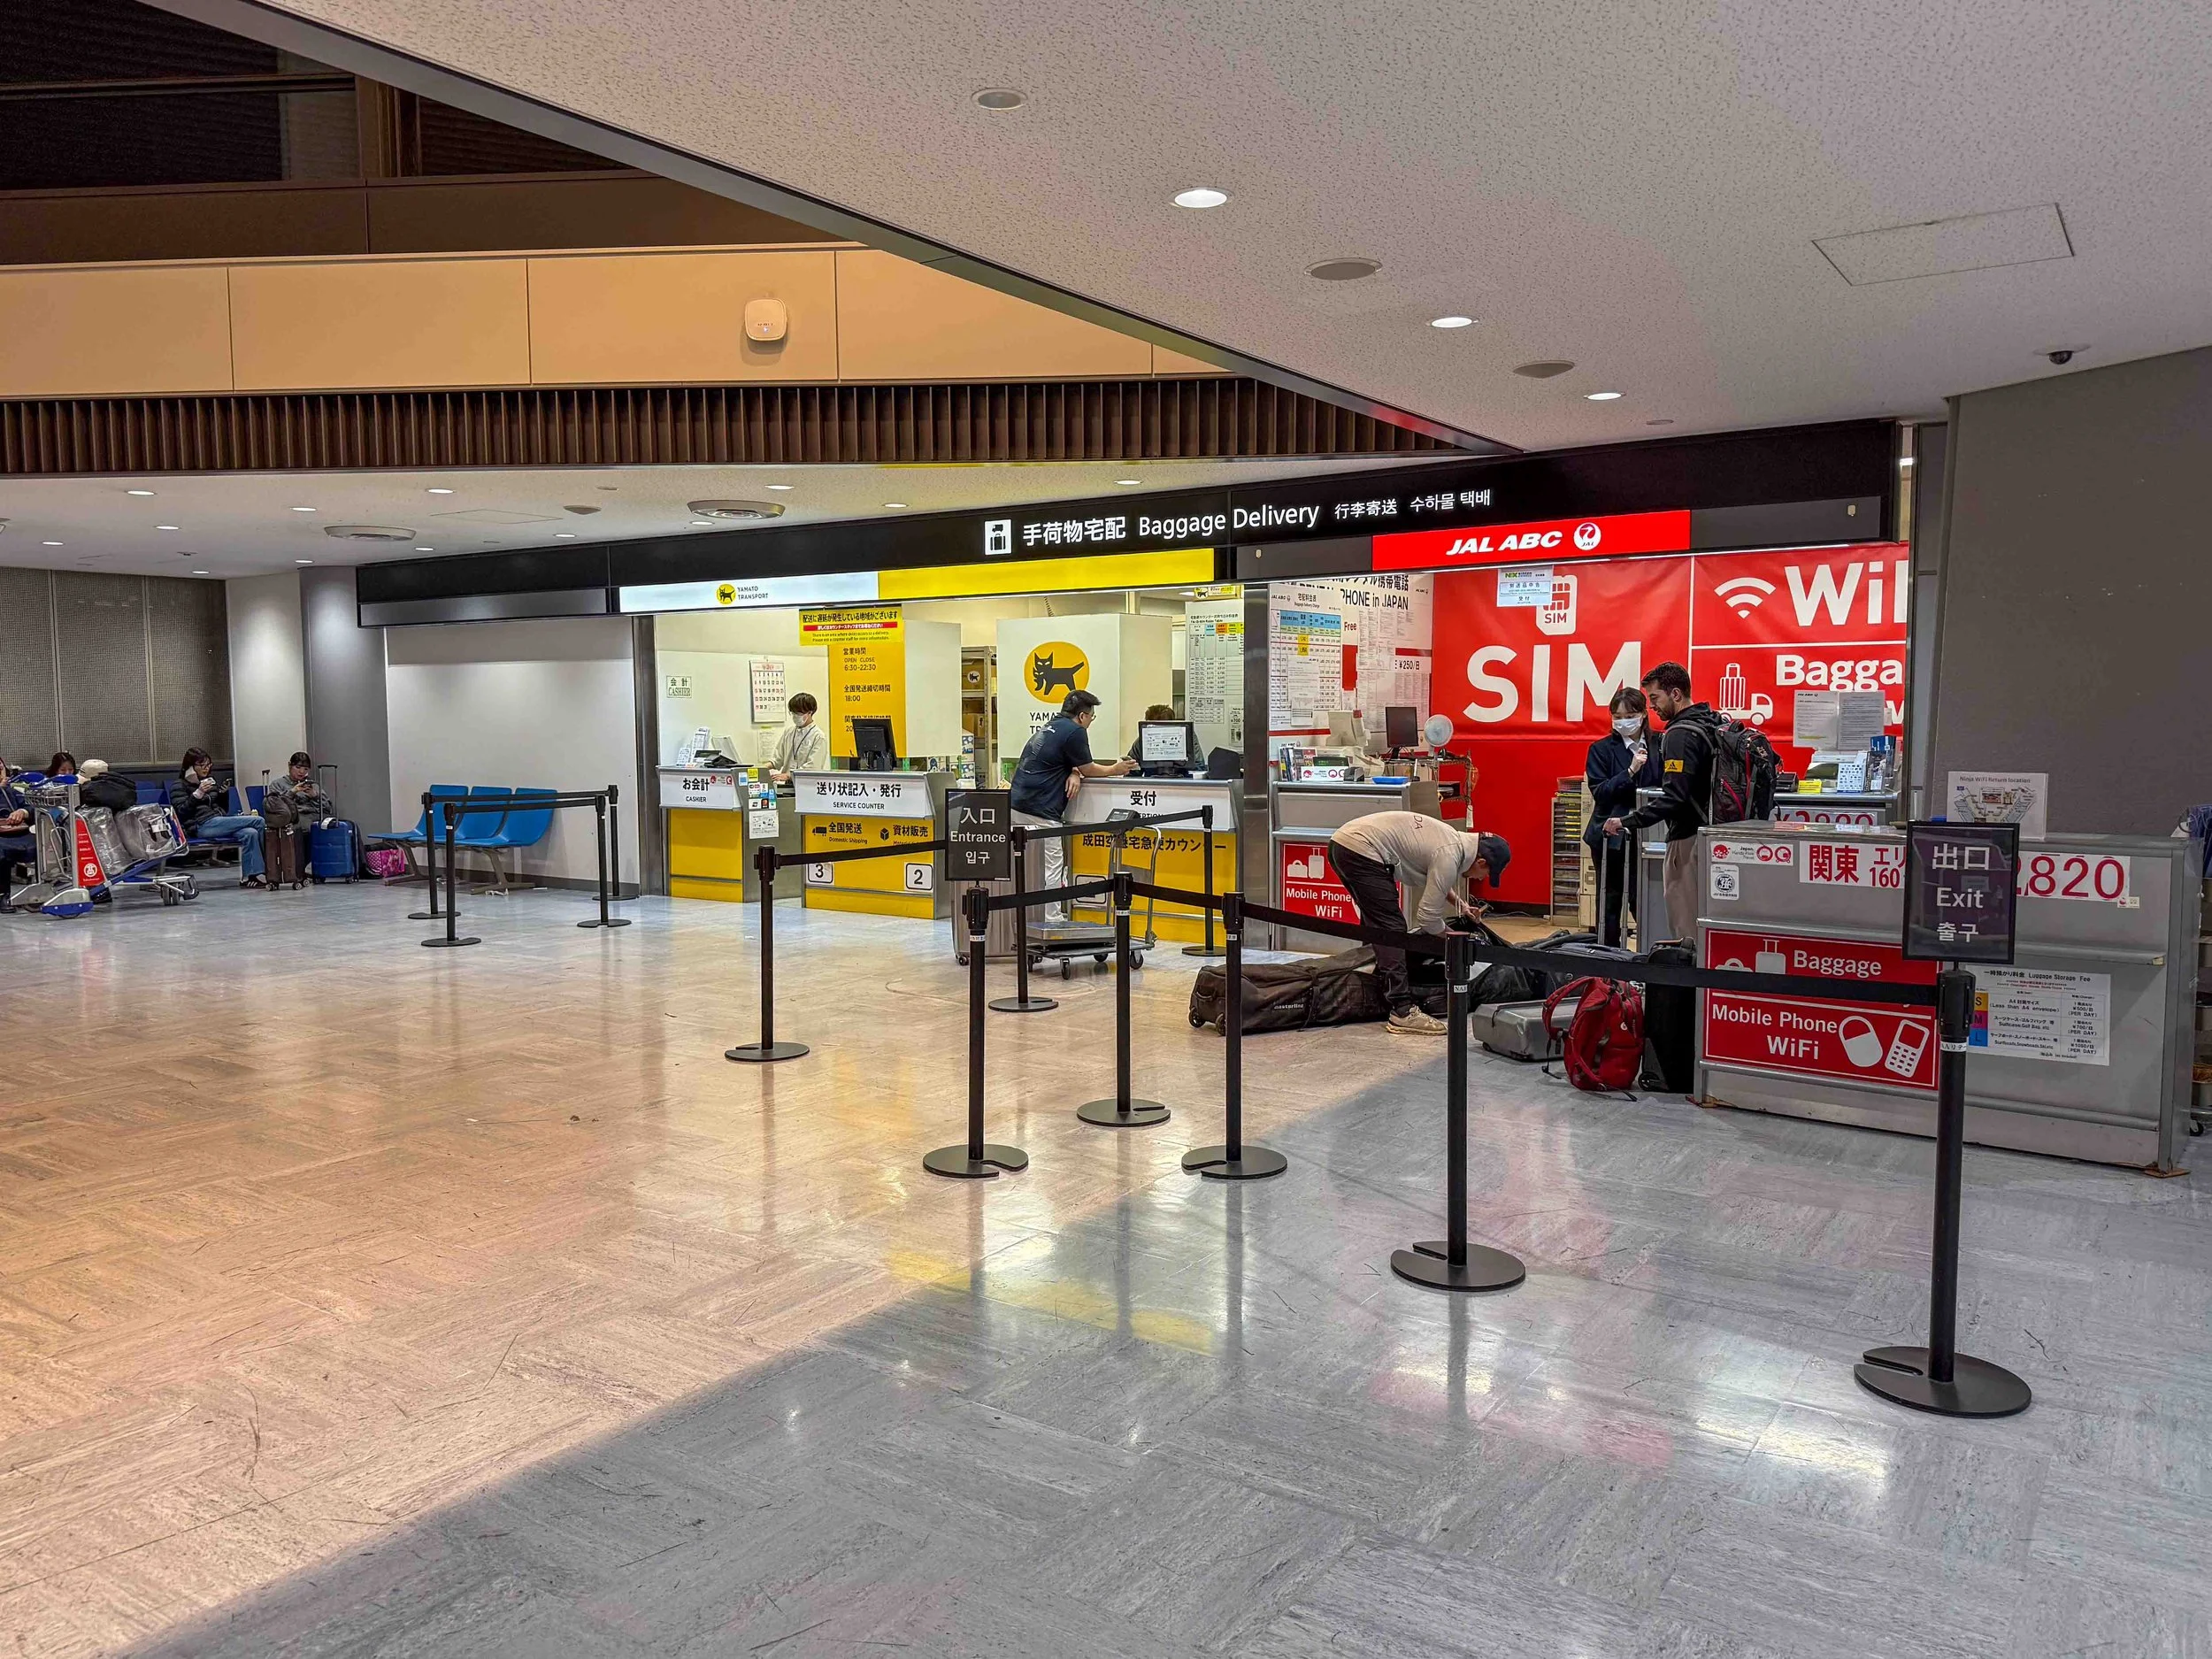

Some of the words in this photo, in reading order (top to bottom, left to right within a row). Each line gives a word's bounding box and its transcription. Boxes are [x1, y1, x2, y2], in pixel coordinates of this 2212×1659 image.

[1334, 497, 1398, 520] 行李寄送
[1409, 493, 1455, 513] 수하물
[1459, 488, 1491, 507] 택배
[1139, 512, 1226, 540] Baggage
[1233, 504, 1319, 529] Delivery
[1023, 516, 1126, 546] 手荷物宅配
[1445, 536, 1494, 556] JAL
[1498, 531, 1563, 552] ABC
[1372, 594, 1379, 608] in
[1382, 594, 1409, 611] JAPAN
[1343, 621, 1357, 631] Free
[1544, 612, 1567, 624] SIM
[843, 647, 866, 656] 営業時間
[1463, 641, 1642, 723] SIM
[668, 687, 691, 697] CASHIER
[682, 778, 710, 791] お会計
[816, 781, 902, 798] 送り状記入・発行
[1130, 790, 1156, 806] 受付
[960, 807, 995, 824] 入口
[828, 822, 862, 834] 全国発送
[893, 824, 928, 837] 資材販売
[950, 830, 1006, 843] Entrance
[965, 851, 990, 864] 입구
[1809, 845, 1860, 883] 関東
[1932, 842, 1990, 871] 出口
[816, 864, 824, 878] 3
[913, 870, 923, 885] 2
[1869, 867, 1901, 888] 160
[1286, 887, 1318, 900] Mobile
[1321, 890, 1351, 902] Phone
[1936, 887, 1984, 909] Exit
[1315, 904, 1343, 918] WiFi
[1936, 922, 1979, 942] 출구
[1793, 949, 1882, 979] Baggage
[1975, 996, 1982, 1006] S
[1712, 1003, 1772, 1026] Mobile
[1779, 1011, 1838, 1034] Phone
[1974, 1014, 1983, 1025] M
[1975, 1032, 1982, 1041] L
[1767, 1034, 1820, 1060] WiFi
